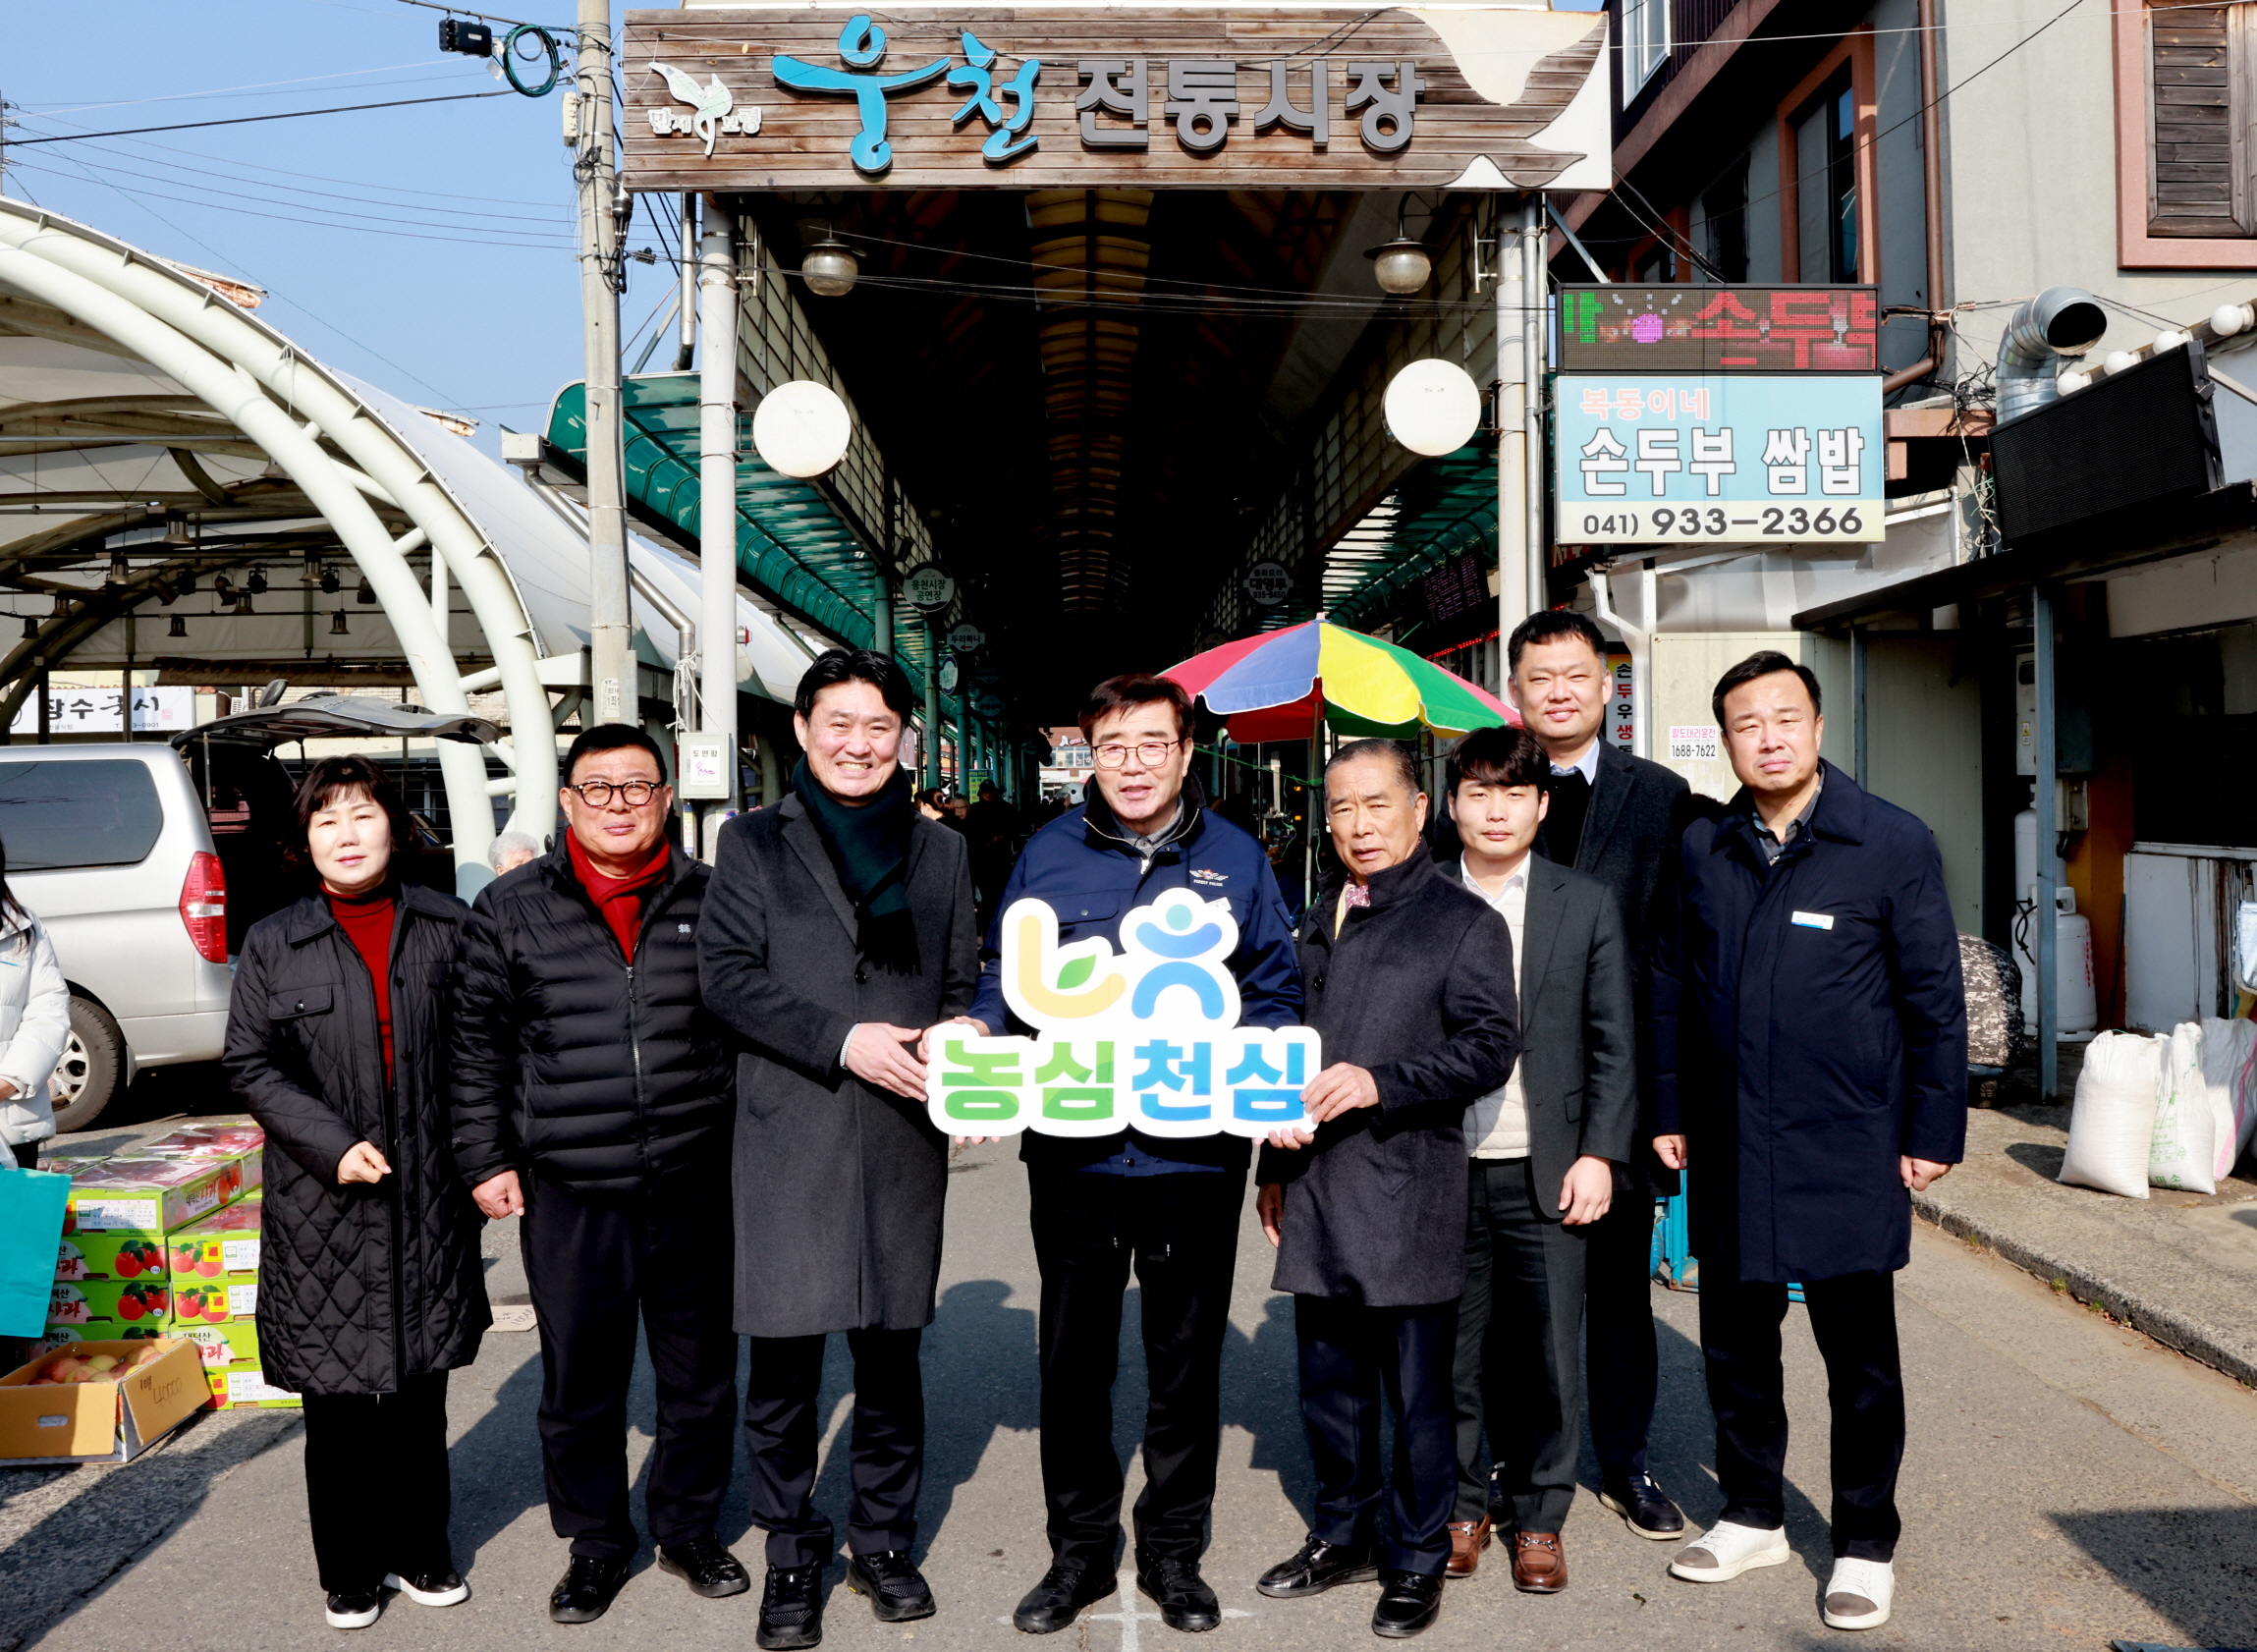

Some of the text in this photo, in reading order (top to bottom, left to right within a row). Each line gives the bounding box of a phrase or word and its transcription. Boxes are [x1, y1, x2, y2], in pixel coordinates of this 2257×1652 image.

[771, 14, 1427, 174] 웅천 전통시장
[1579, 387, 1710, 420] 복동이네
[1579, 426, 1865, 496] 손두부 쌈밥
[1583, 507, 1863, 536] 041) 933-2366
[911, 579, 946, 591] 웅천시장
[916, 590, 942, 601] 공연장
[951, 634, 981, 643] 두리하나
[1672, 728, 1716, 739] 팔도대리운전
[1672, 744, 1716, 757] 1688-7622
[942, 1038, 1305, 1121] 농심천심
[200, 1180, 216, 1201] 사과
[57, 1258, 78, 1275] 과
[52, 1289, 69, 1298] 덕산
